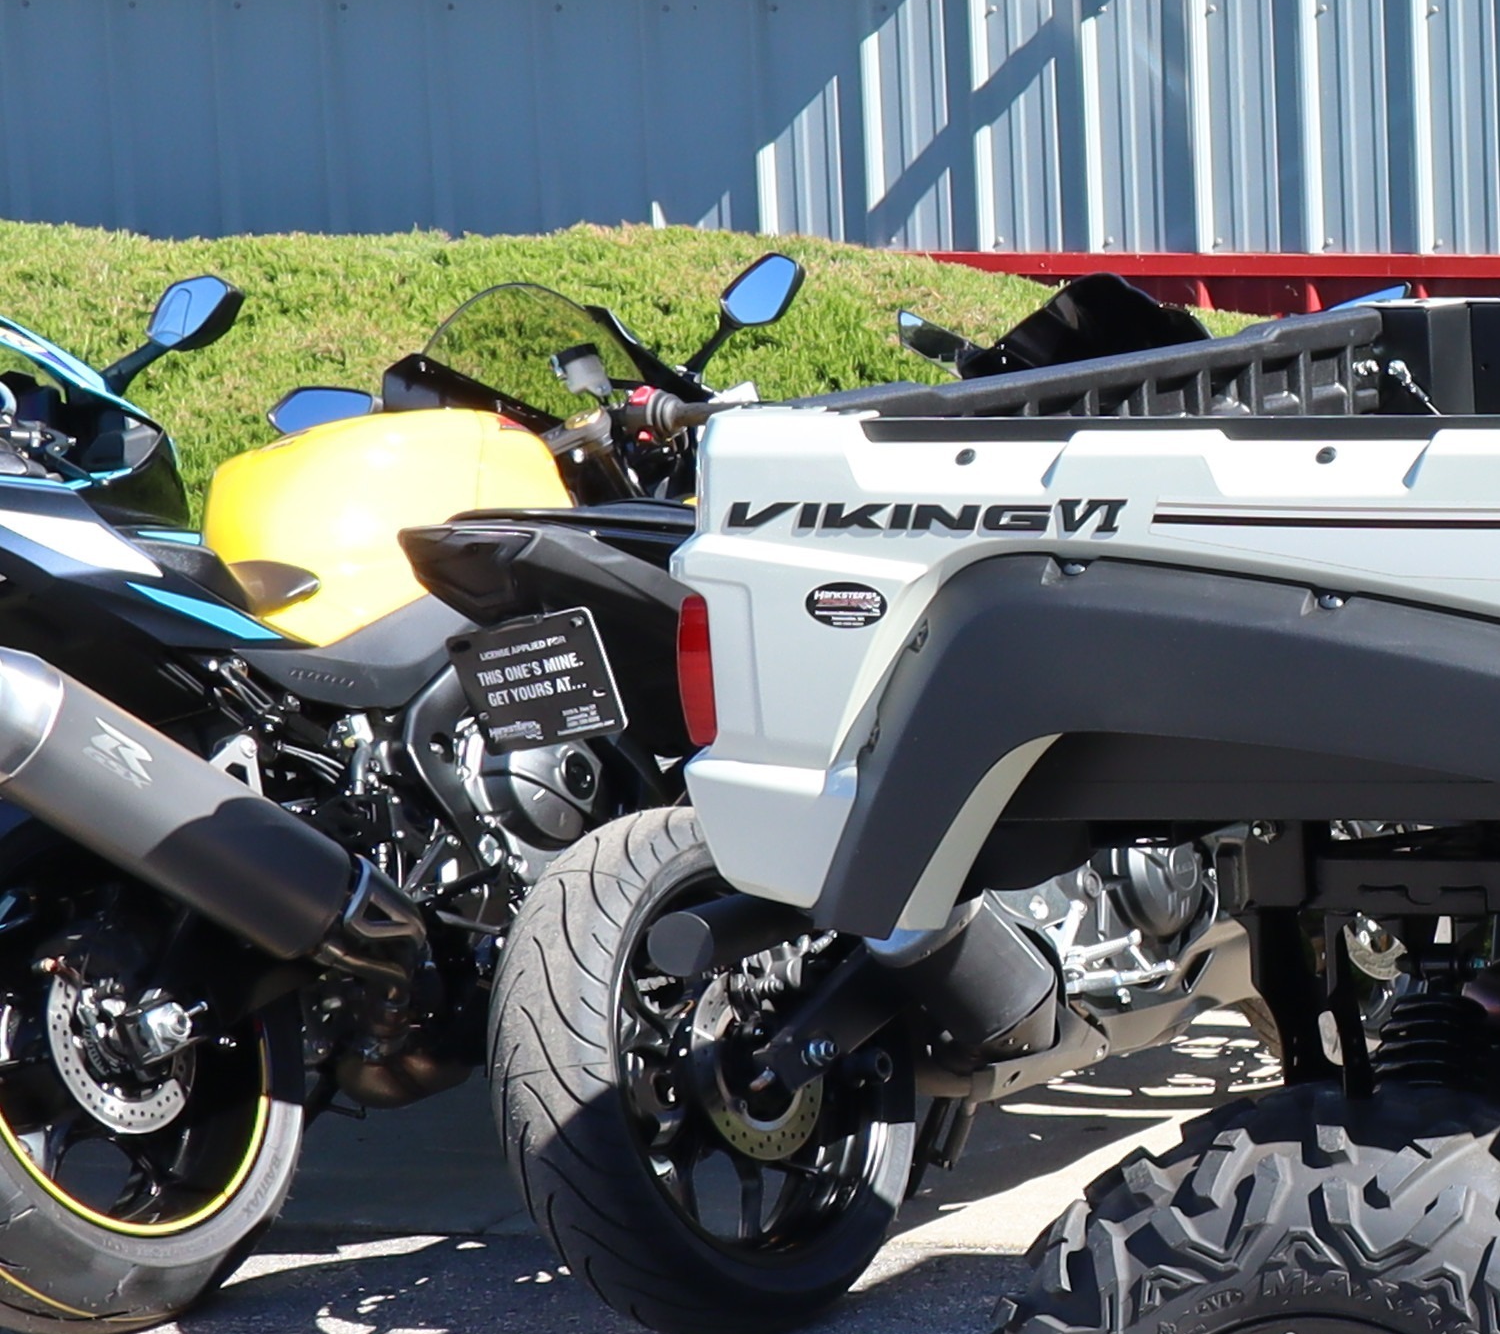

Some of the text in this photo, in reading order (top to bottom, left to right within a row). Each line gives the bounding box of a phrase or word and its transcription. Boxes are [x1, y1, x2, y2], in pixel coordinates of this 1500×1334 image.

[727, 498, 1129, 533] VIKING VI
[477, 652, 584, 687] THIS ONE'S MINE.
[487, 689, 511, 708] GET
[511, 682, 554, 703] YOURS
